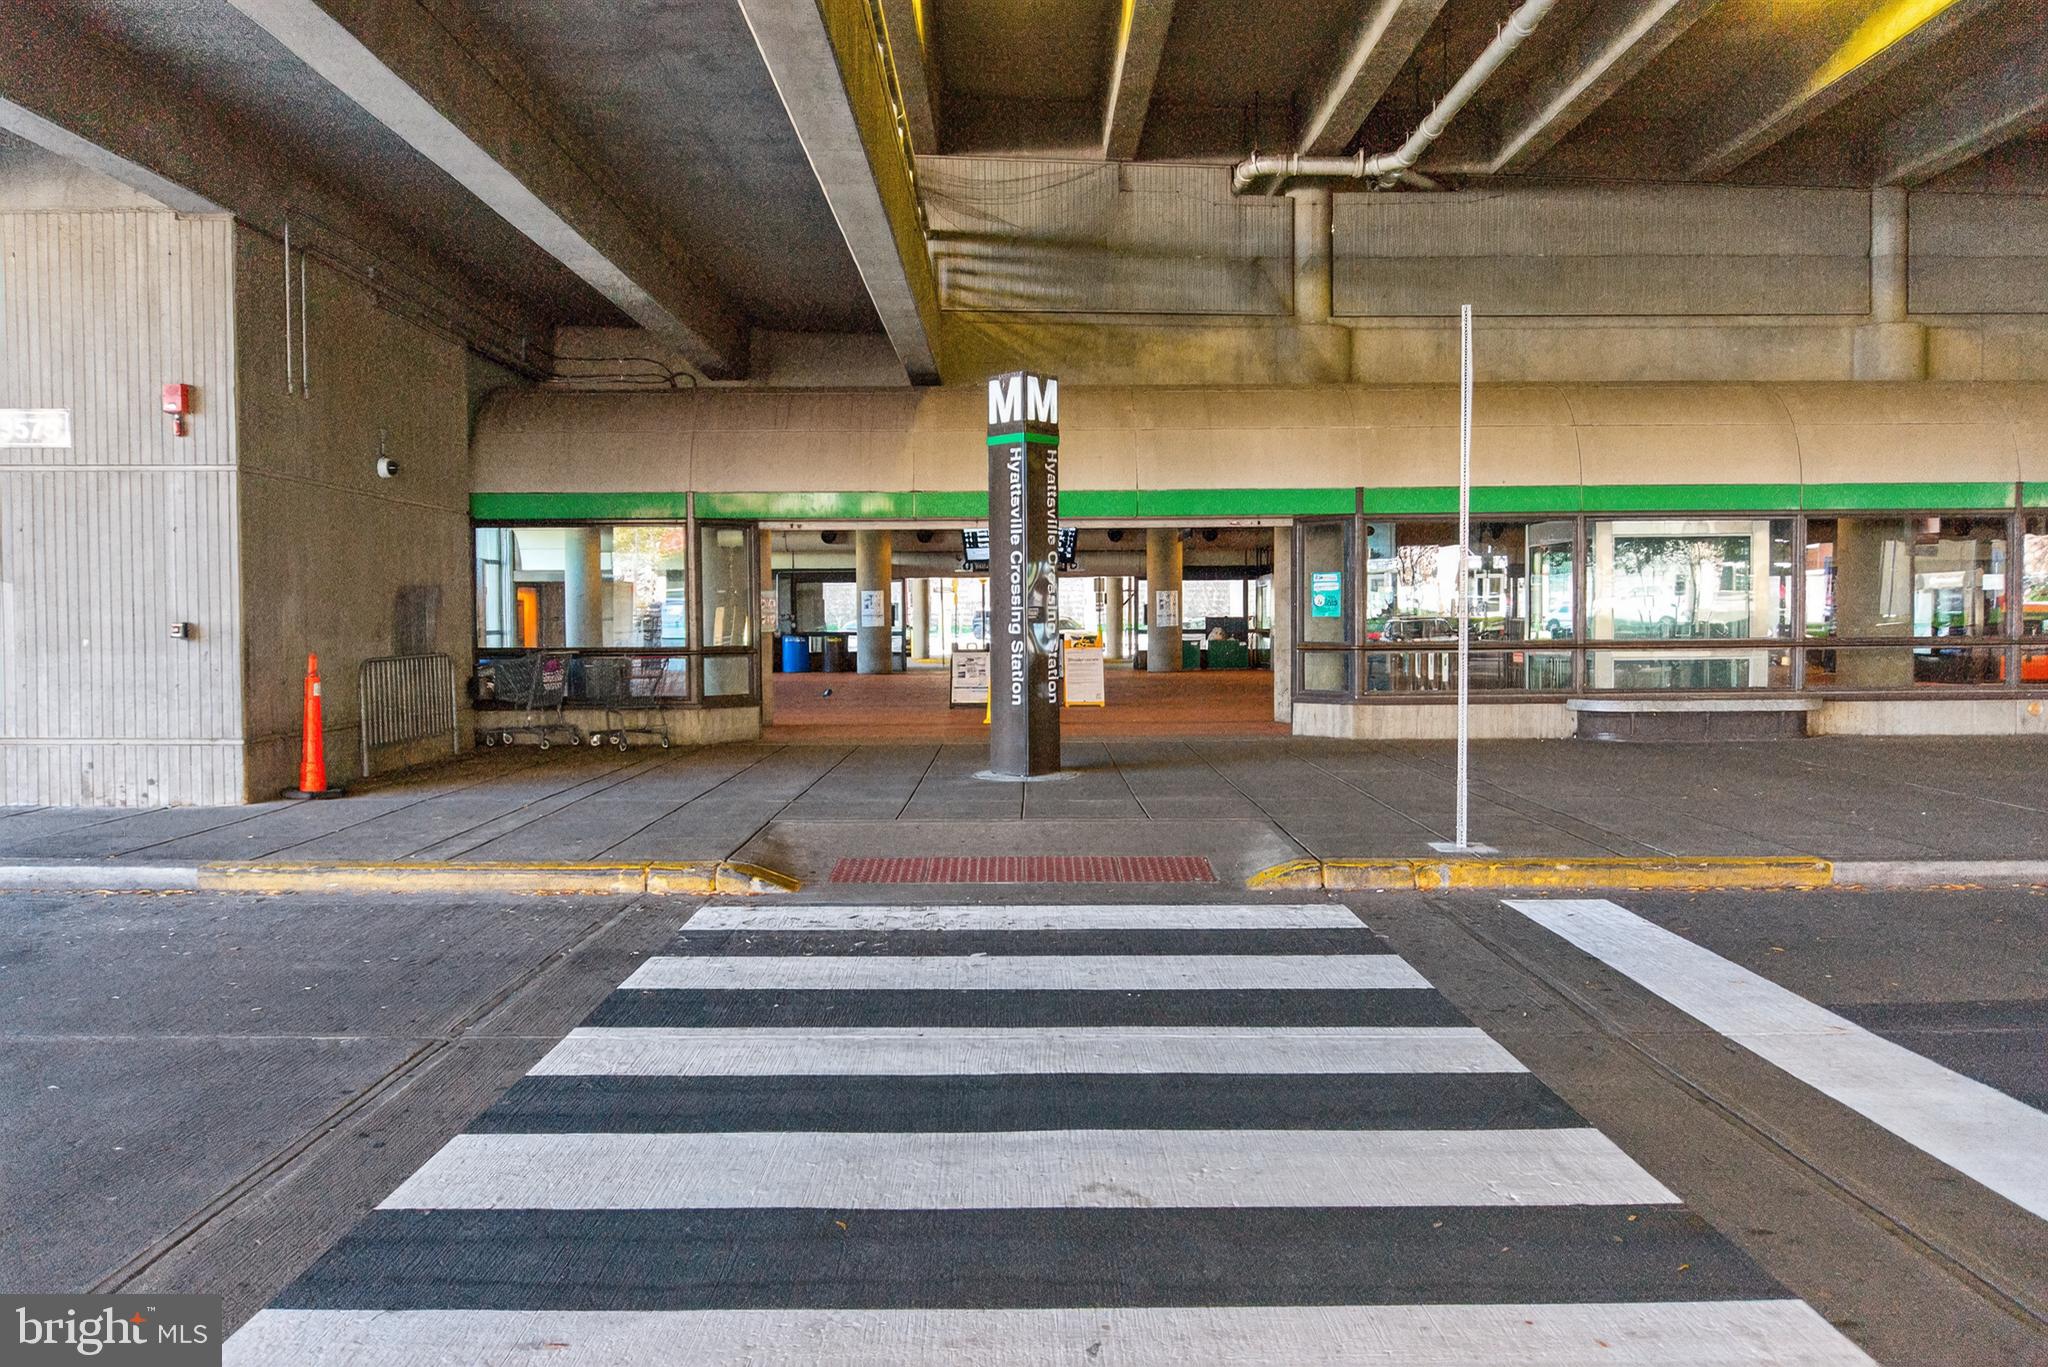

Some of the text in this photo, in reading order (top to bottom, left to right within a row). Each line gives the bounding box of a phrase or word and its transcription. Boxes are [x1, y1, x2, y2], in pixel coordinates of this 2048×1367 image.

[988, 375, 1022, 425] M
[1026, 375, 1058, 425] M
[1045, 449, 1058, 545] Hyattsville
[1007, 447, 1024, 706] Hyattsville Crossing Station
